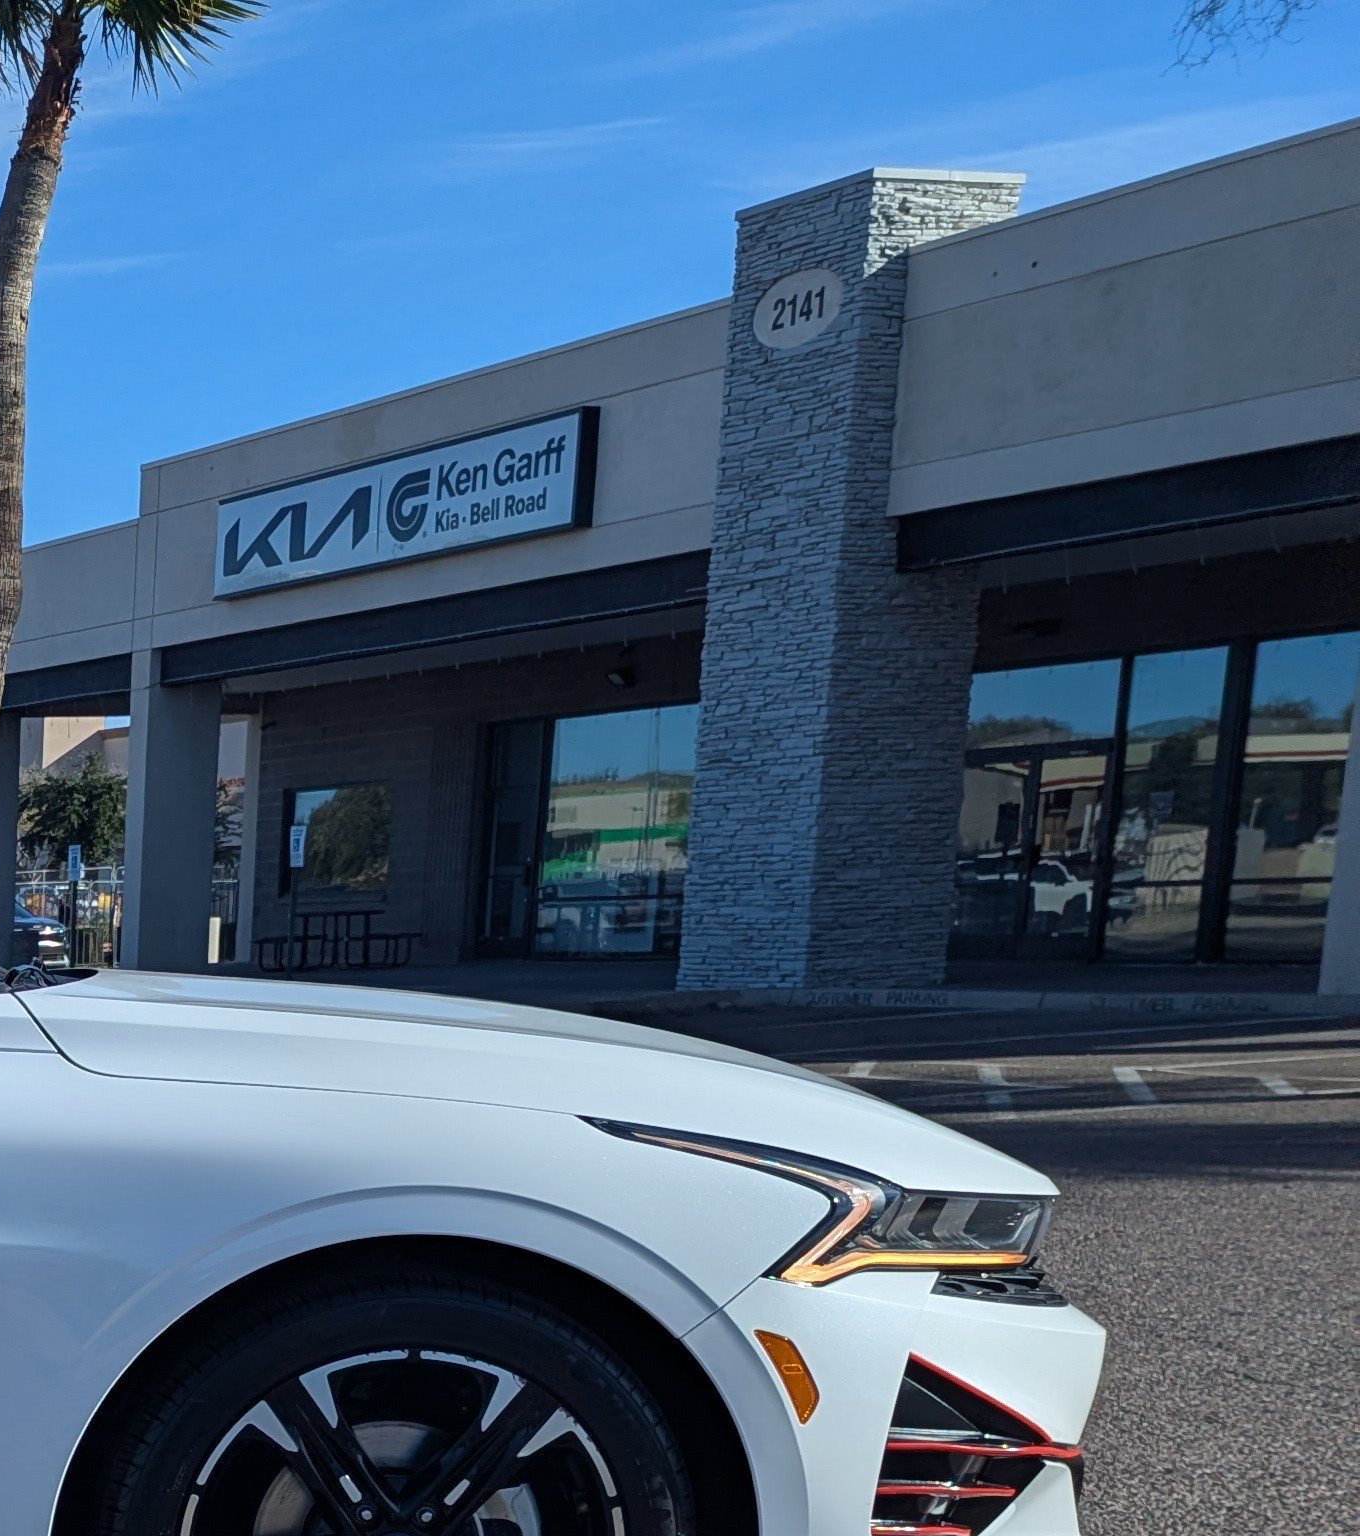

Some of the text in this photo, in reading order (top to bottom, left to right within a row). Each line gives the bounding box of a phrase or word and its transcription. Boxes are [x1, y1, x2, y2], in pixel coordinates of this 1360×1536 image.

[771, 286, 826, 331] 2141
[436, 434, 566, 501] Ken Garff
[223, 485, 372, 577] KIA
[434, 486, 547, 533] Kia Bell Road
